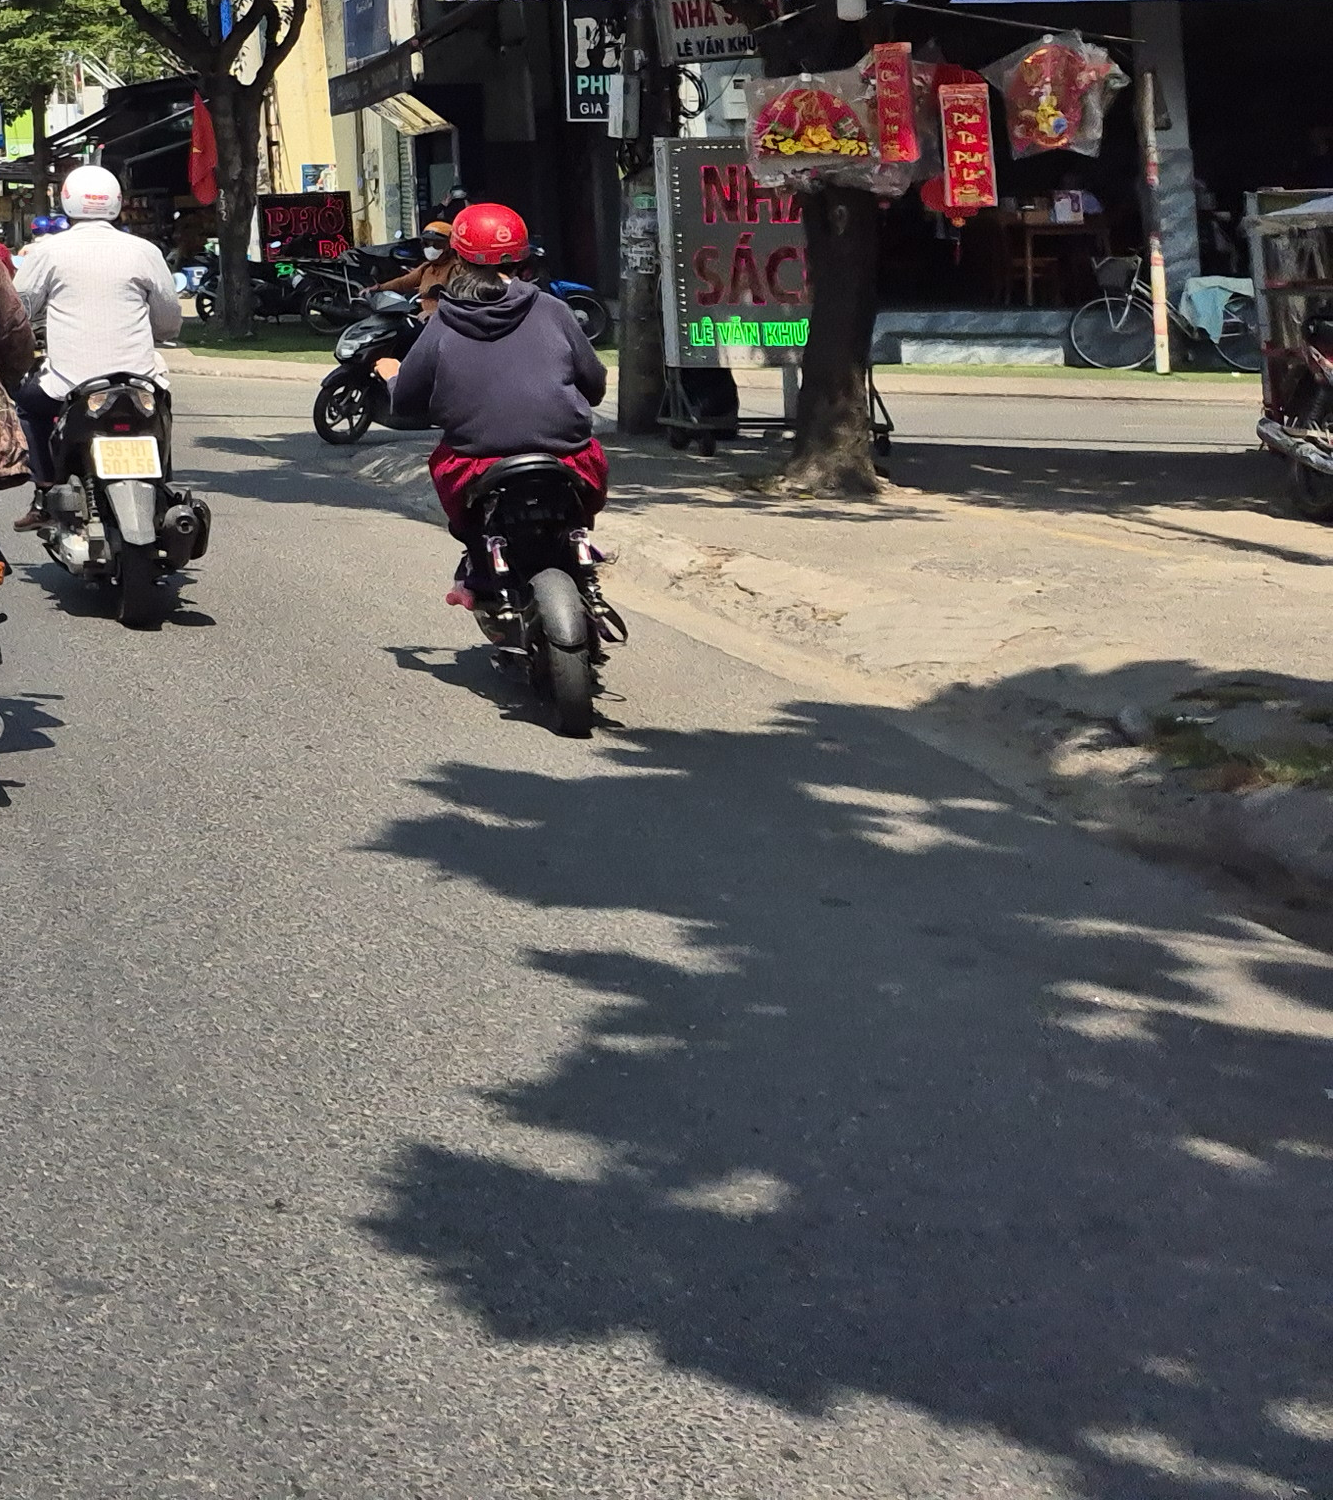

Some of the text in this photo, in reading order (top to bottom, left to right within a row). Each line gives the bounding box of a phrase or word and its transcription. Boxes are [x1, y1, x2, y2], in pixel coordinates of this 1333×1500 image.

[579, 102, 603, 115] GIA
[692, 231, 812, 307] SÁC
[689, 316, 715, 347] LÊ
[715, 316, 761, 347] VĂN
